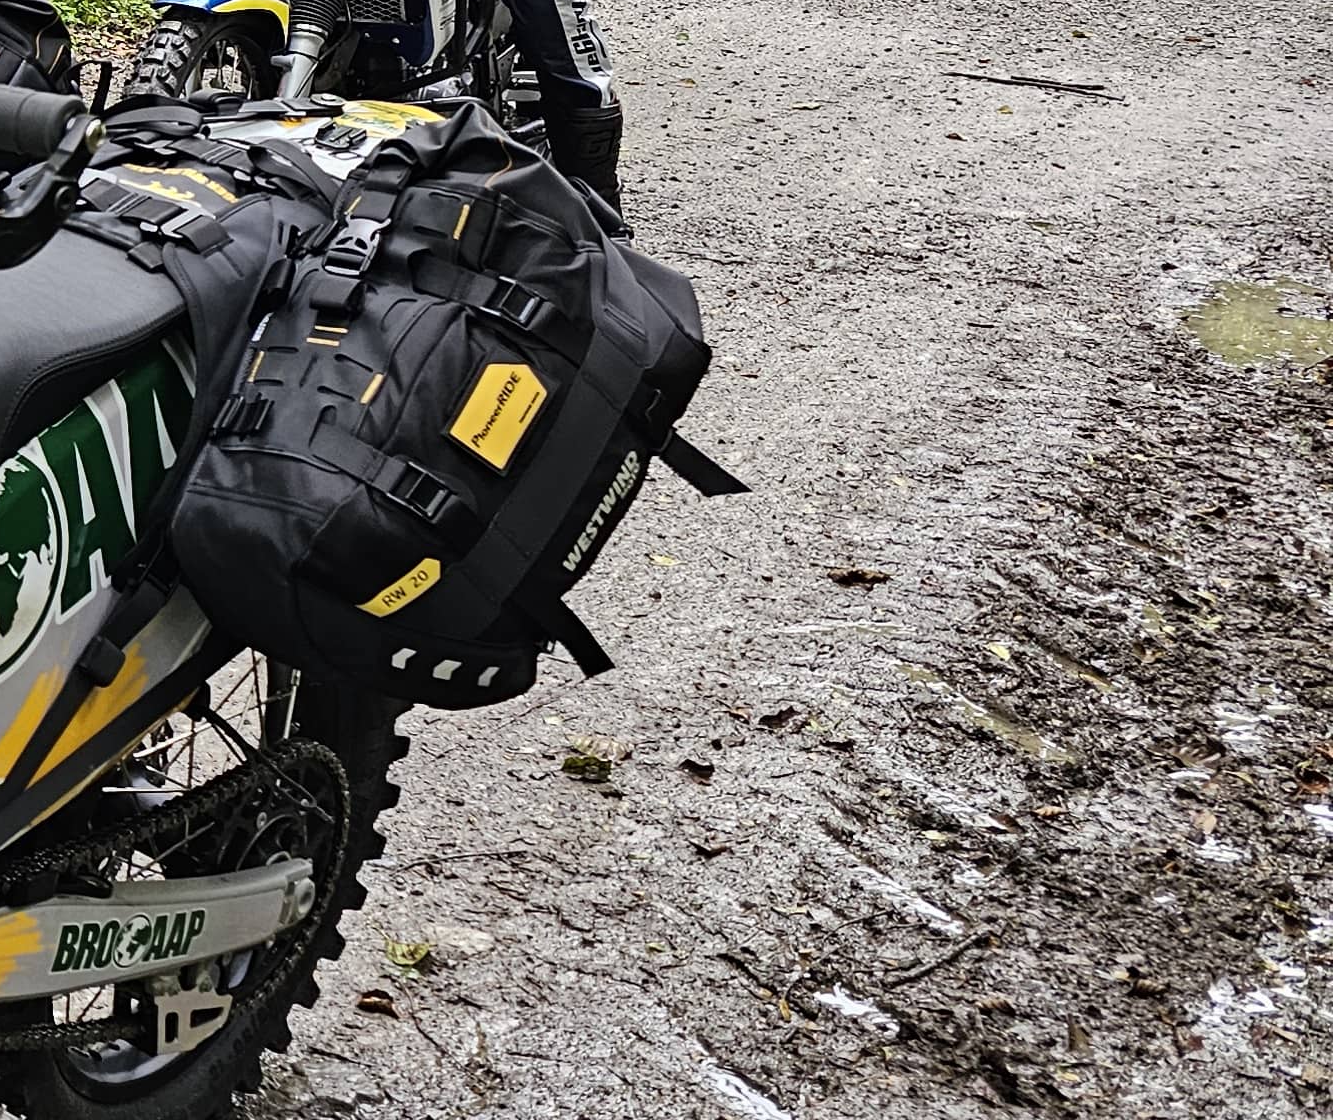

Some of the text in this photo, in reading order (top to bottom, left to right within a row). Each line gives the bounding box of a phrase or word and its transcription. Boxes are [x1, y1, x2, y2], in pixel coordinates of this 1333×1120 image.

[562, 450, 638, 572] WESTWIND
[381, 570, 429, 607] RW 20
